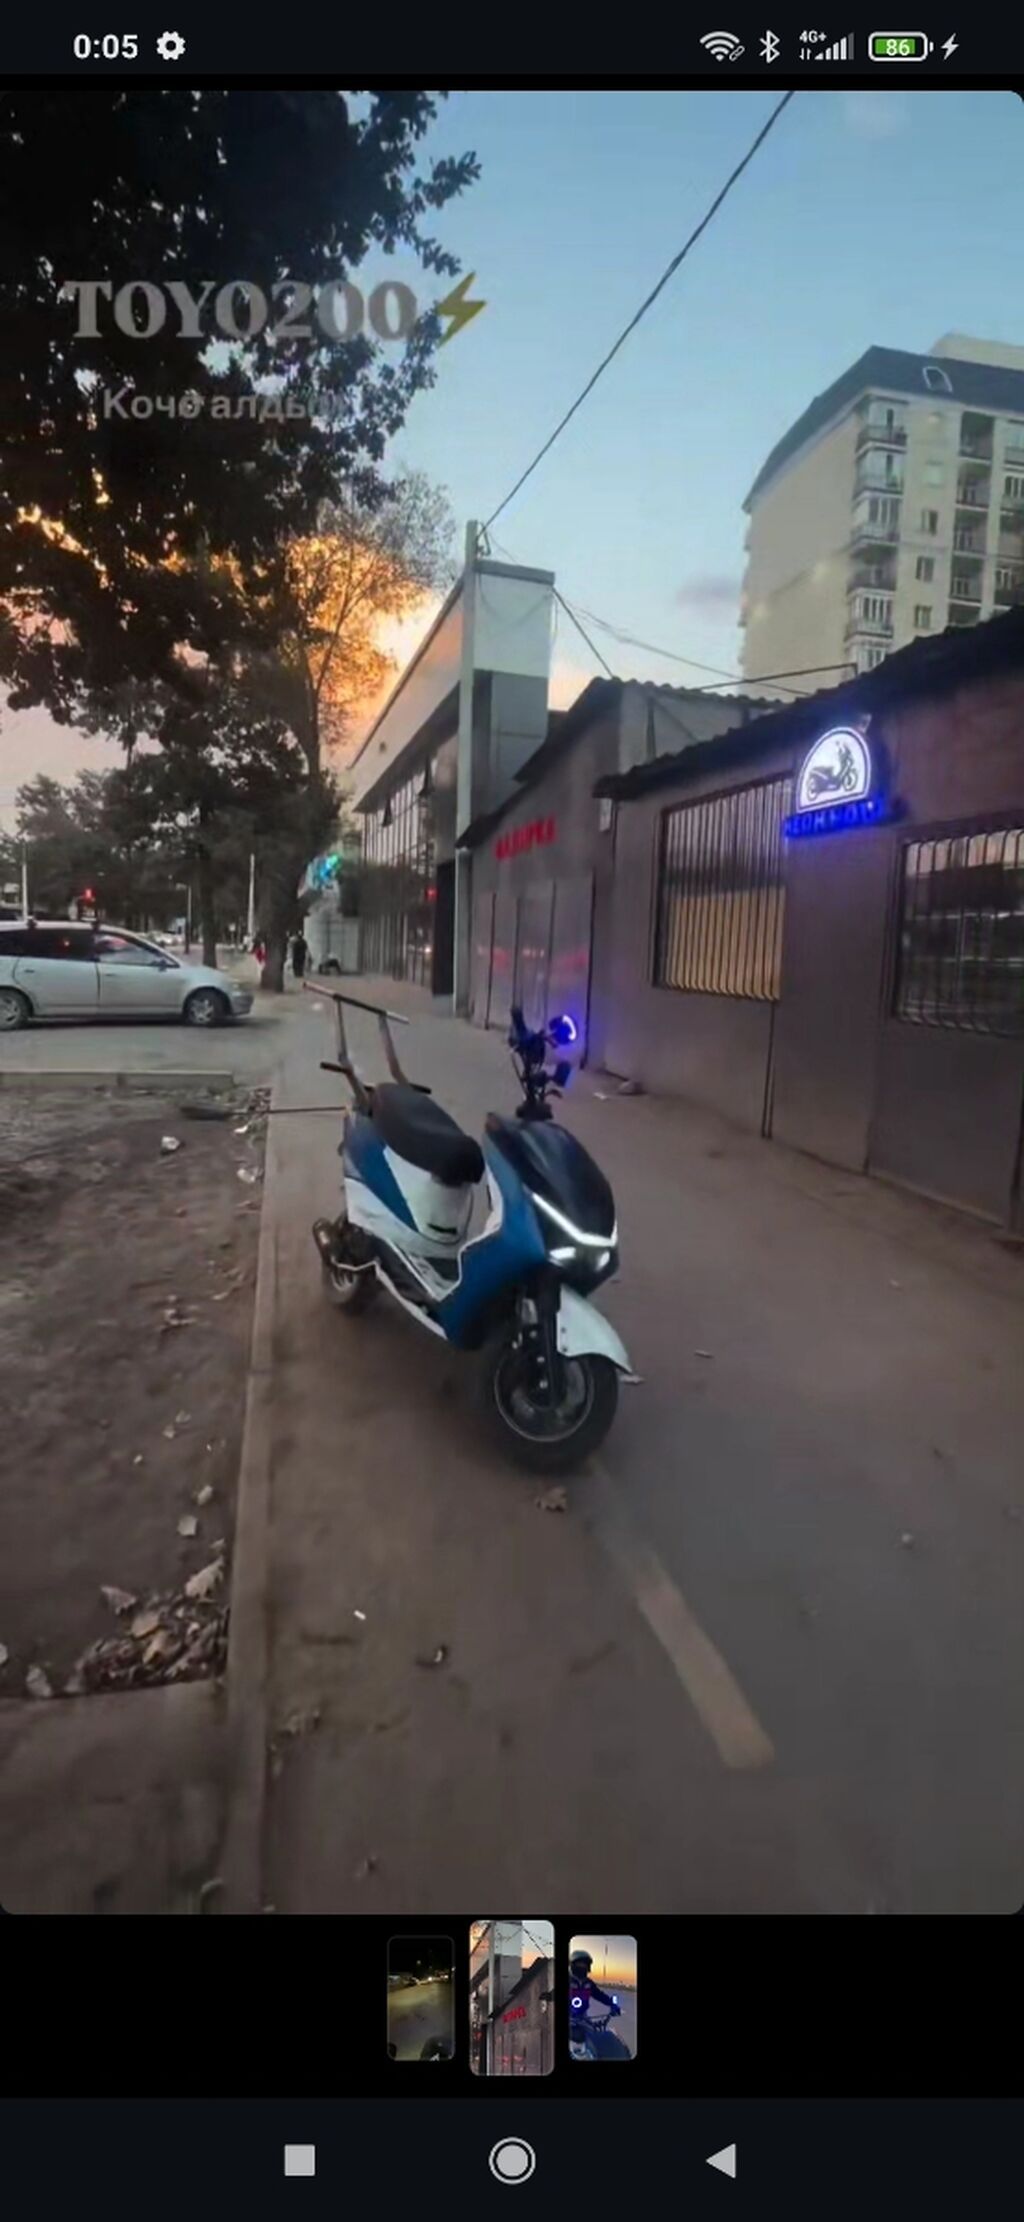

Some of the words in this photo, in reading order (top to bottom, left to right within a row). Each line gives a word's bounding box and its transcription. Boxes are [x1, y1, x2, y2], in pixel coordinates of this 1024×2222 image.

[799, 30, 827, 43] 4G+
[73, 33, 139, 59] 0:05
[886, 39, 910, 56] 86
